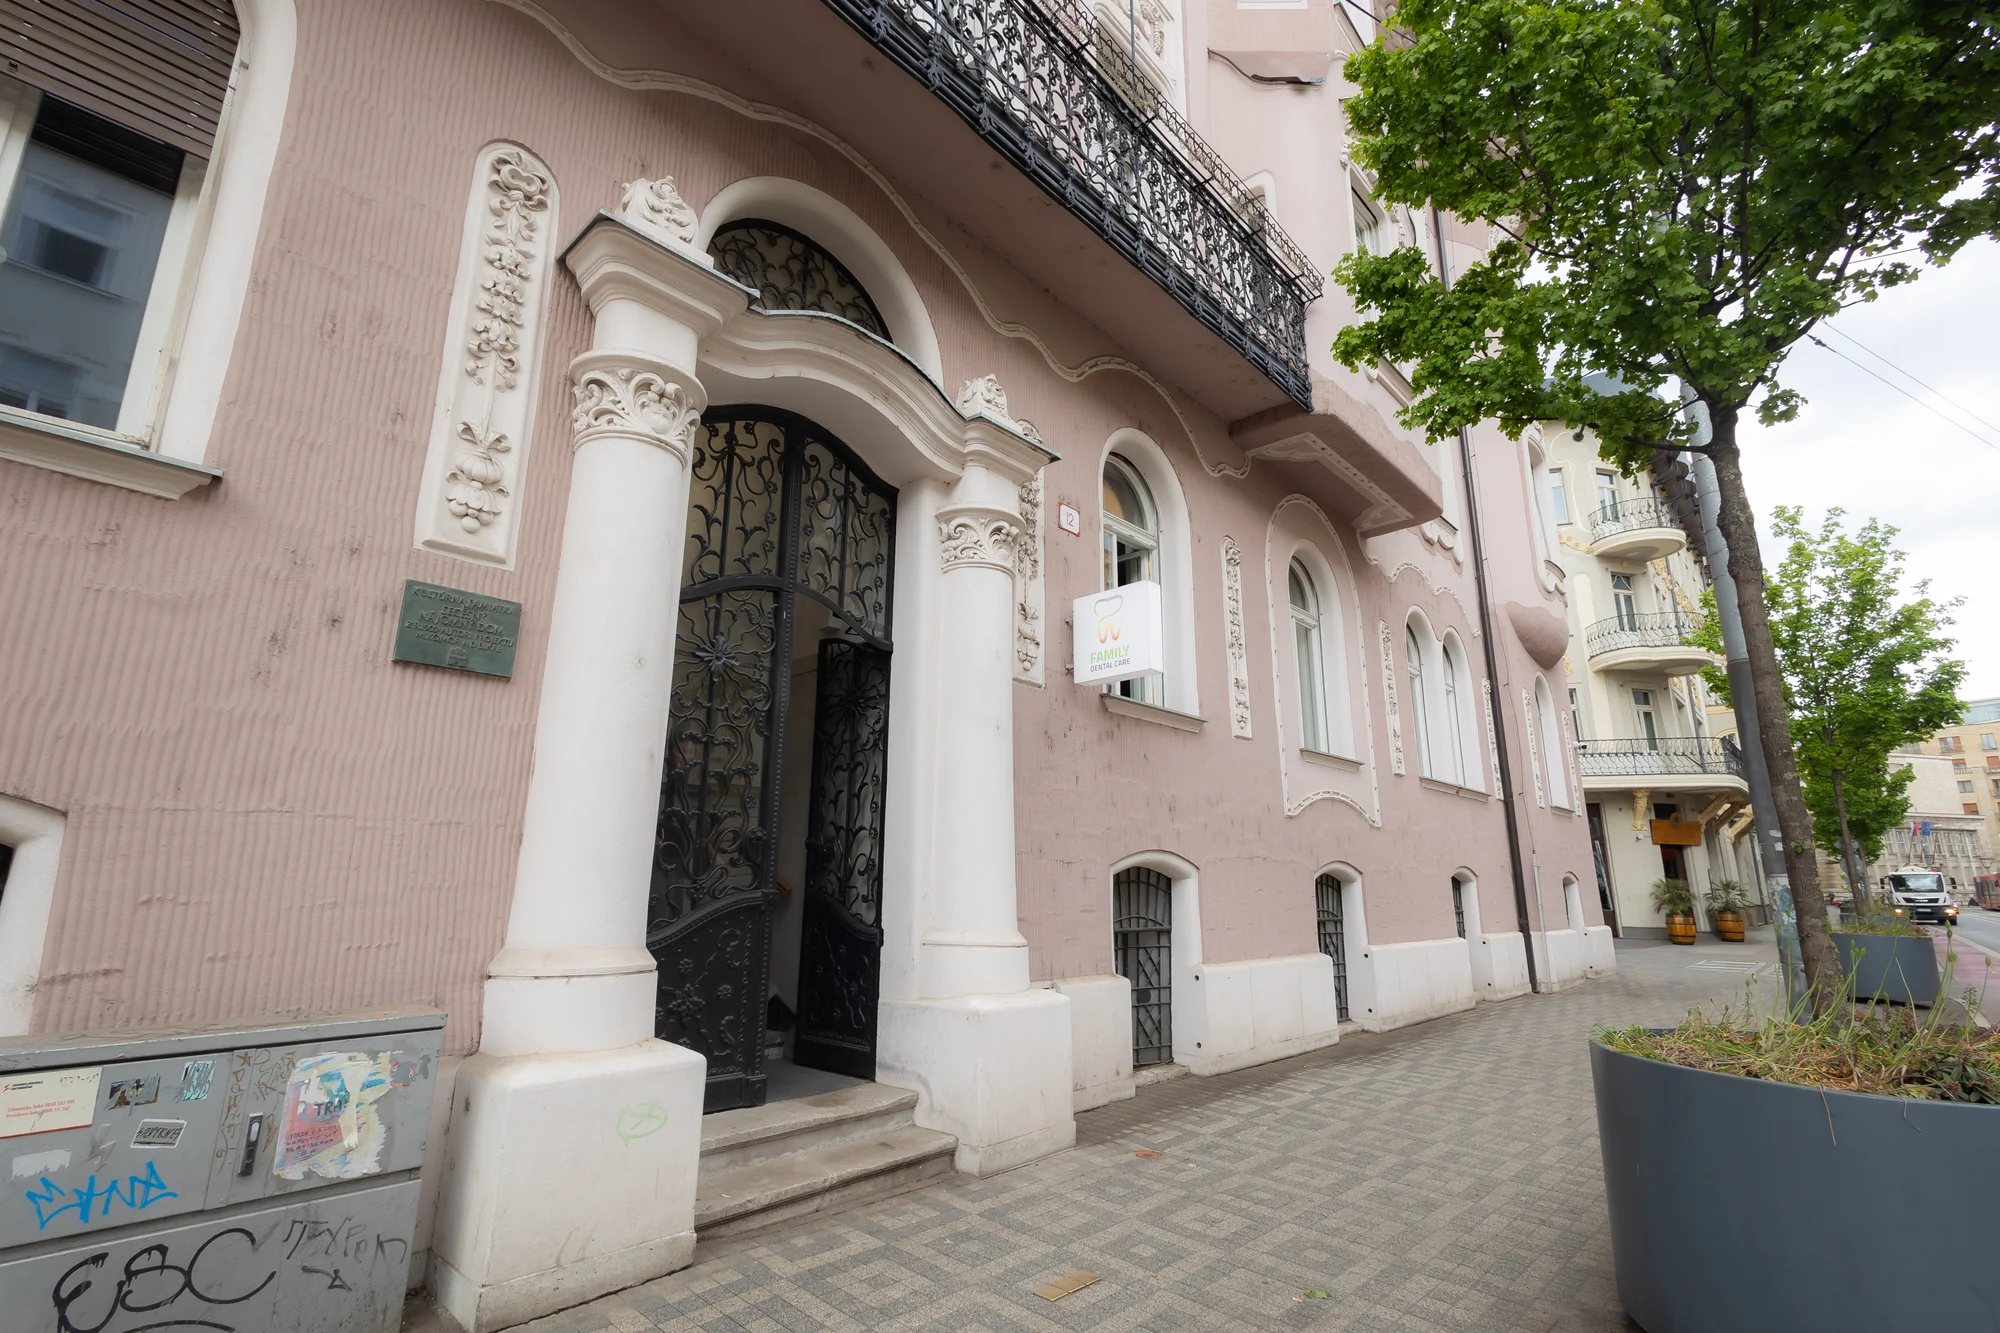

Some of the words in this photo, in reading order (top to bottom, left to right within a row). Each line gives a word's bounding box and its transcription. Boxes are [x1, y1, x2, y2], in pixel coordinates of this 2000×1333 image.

[1066, 511, 1075, 527] 12
[474, 634, 514, 648] PROJEKTU
[1090, 645, 1130, 664] FAMILY
[1090, 662, 1113, 672] DENTAL
[1114, 658, 1130, 668] CARE
